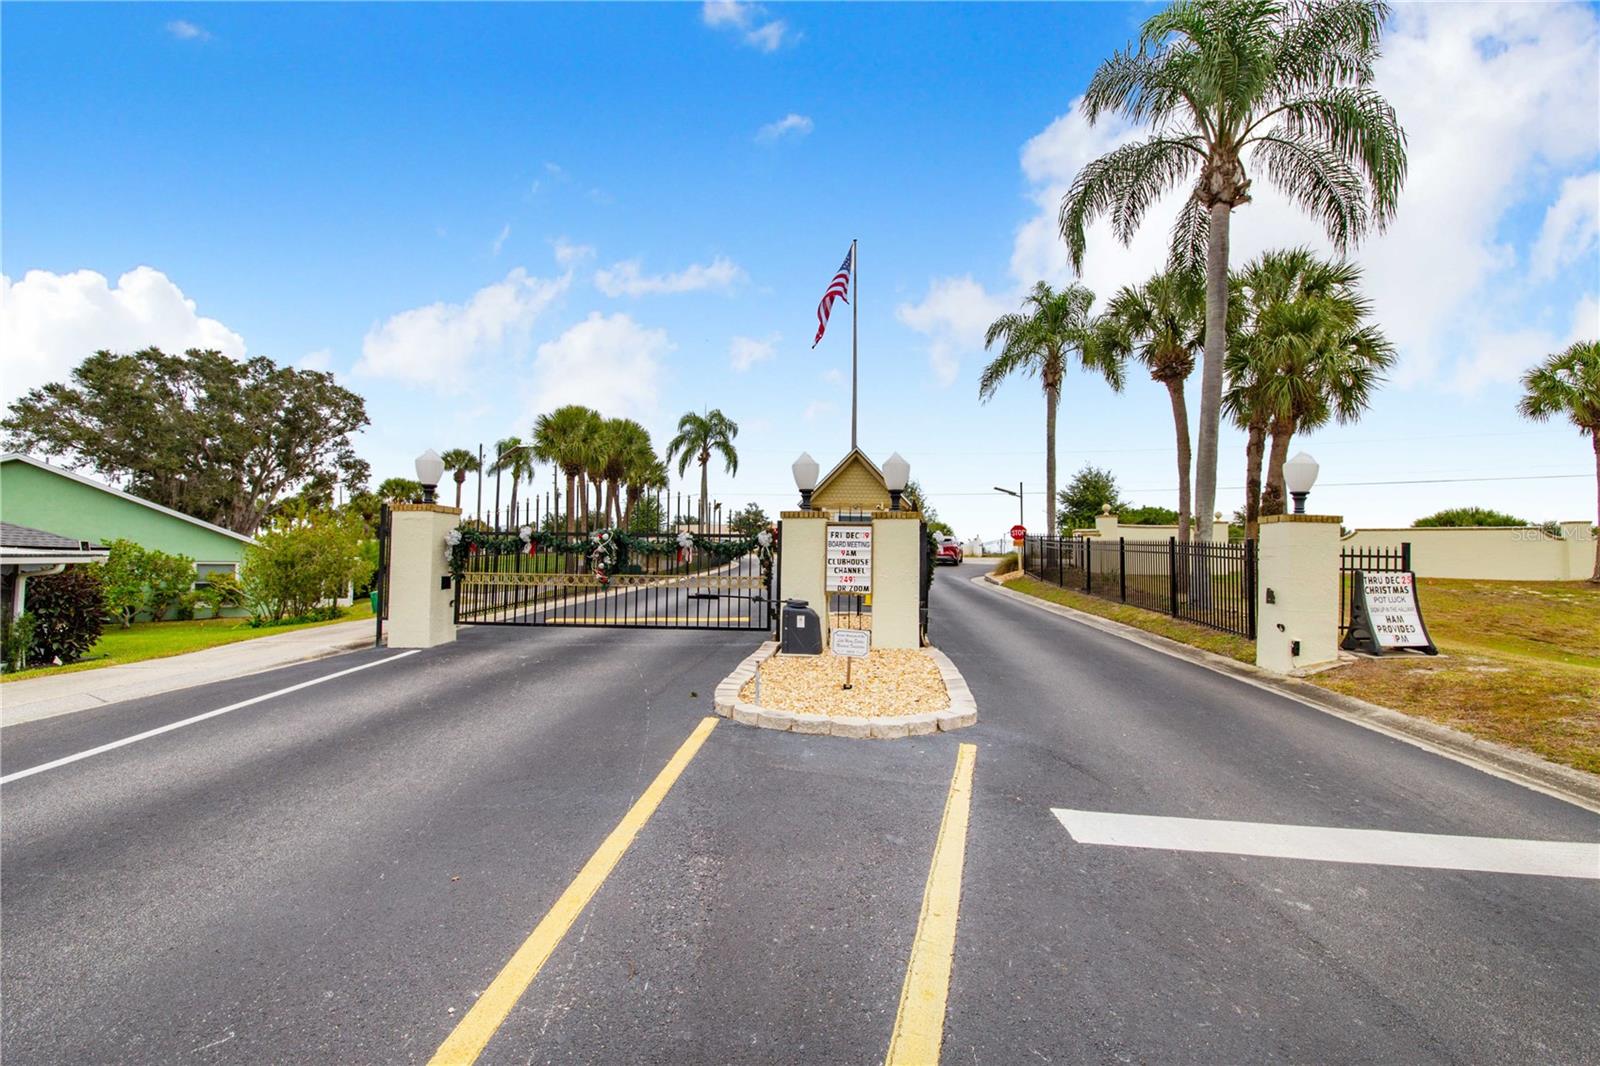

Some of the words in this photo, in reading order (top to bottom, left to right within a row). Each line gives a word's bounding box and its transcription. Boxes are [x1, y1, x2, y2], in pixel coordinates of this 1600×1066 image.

[830, 531, 842, 539] FRI
[845, 531, 860, 539] DEC
[828, 540, 846, 548] BOARD
[847, 540, 870, 548] MEETING
[1363, 576, 1383, 584] THRU
[1385, 576, 1400, 584] DEC
[837, 584, 847, 592] OR
[1365, 586, 1409, 594] CHRISTMAS
[1385, 615, 1404, 623] HAM
[1377, 624, 1416, 634] PROVIDED
